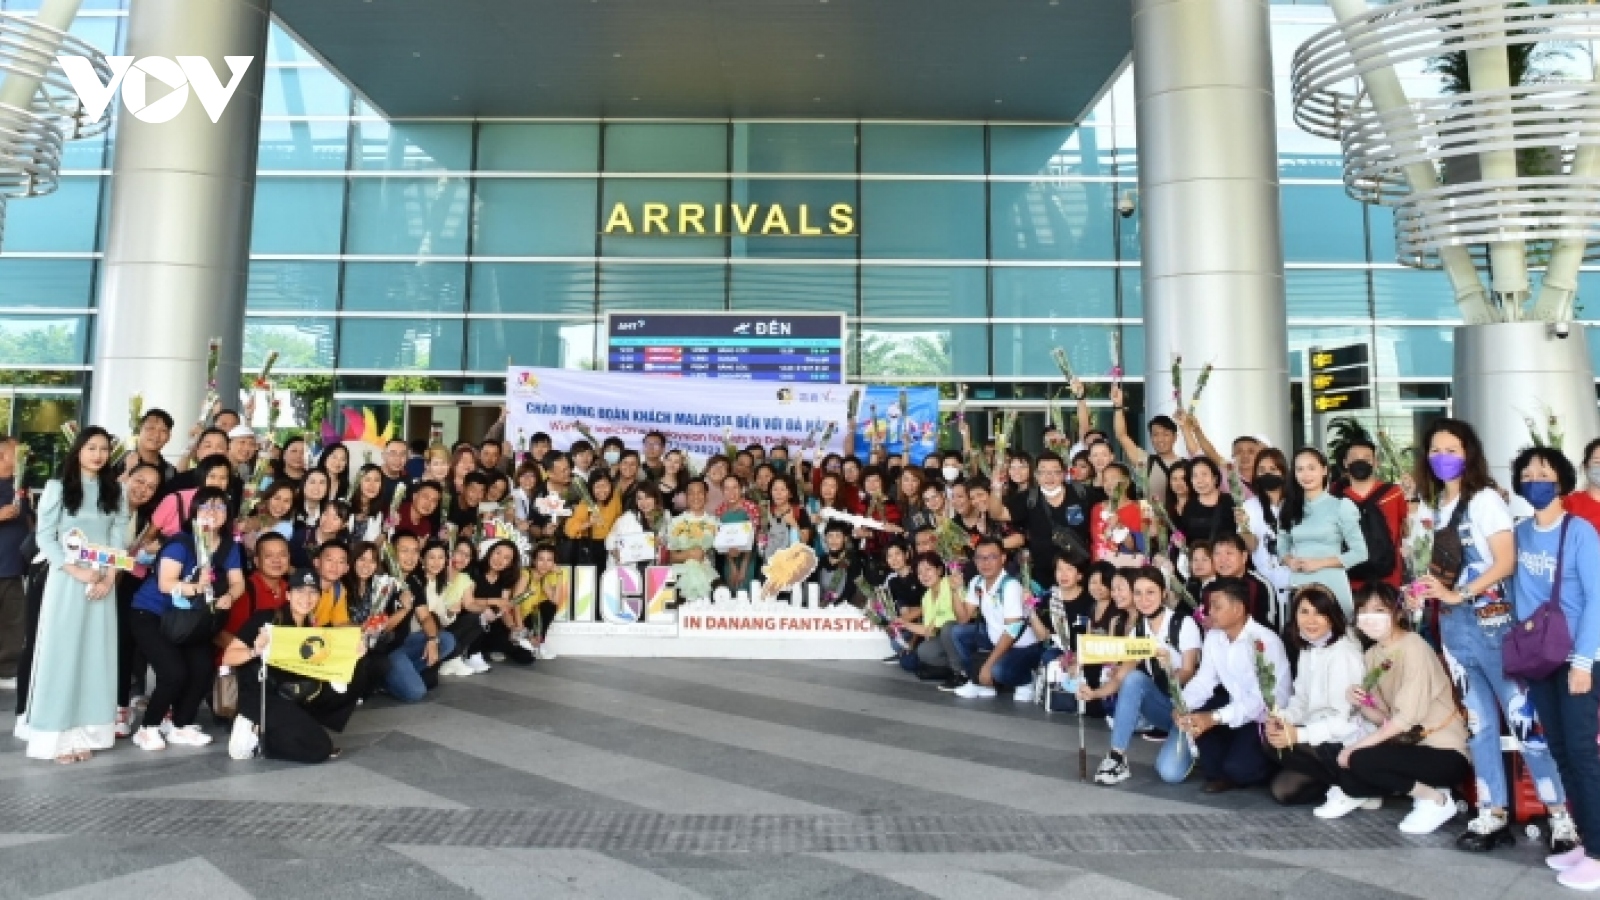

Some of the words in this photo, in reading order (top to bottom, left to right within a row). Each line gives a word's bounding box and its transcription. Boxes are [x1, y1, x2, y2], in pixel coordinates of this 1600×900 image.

[604, 202, 855, 235] ARRIVALS
[754, 318, 791, 335] ĐẾN
[674, 412, 732, 427] MALAYSIA
[683, 615, 700, 631] IN
[705, 616, 775, 631] DANANG
